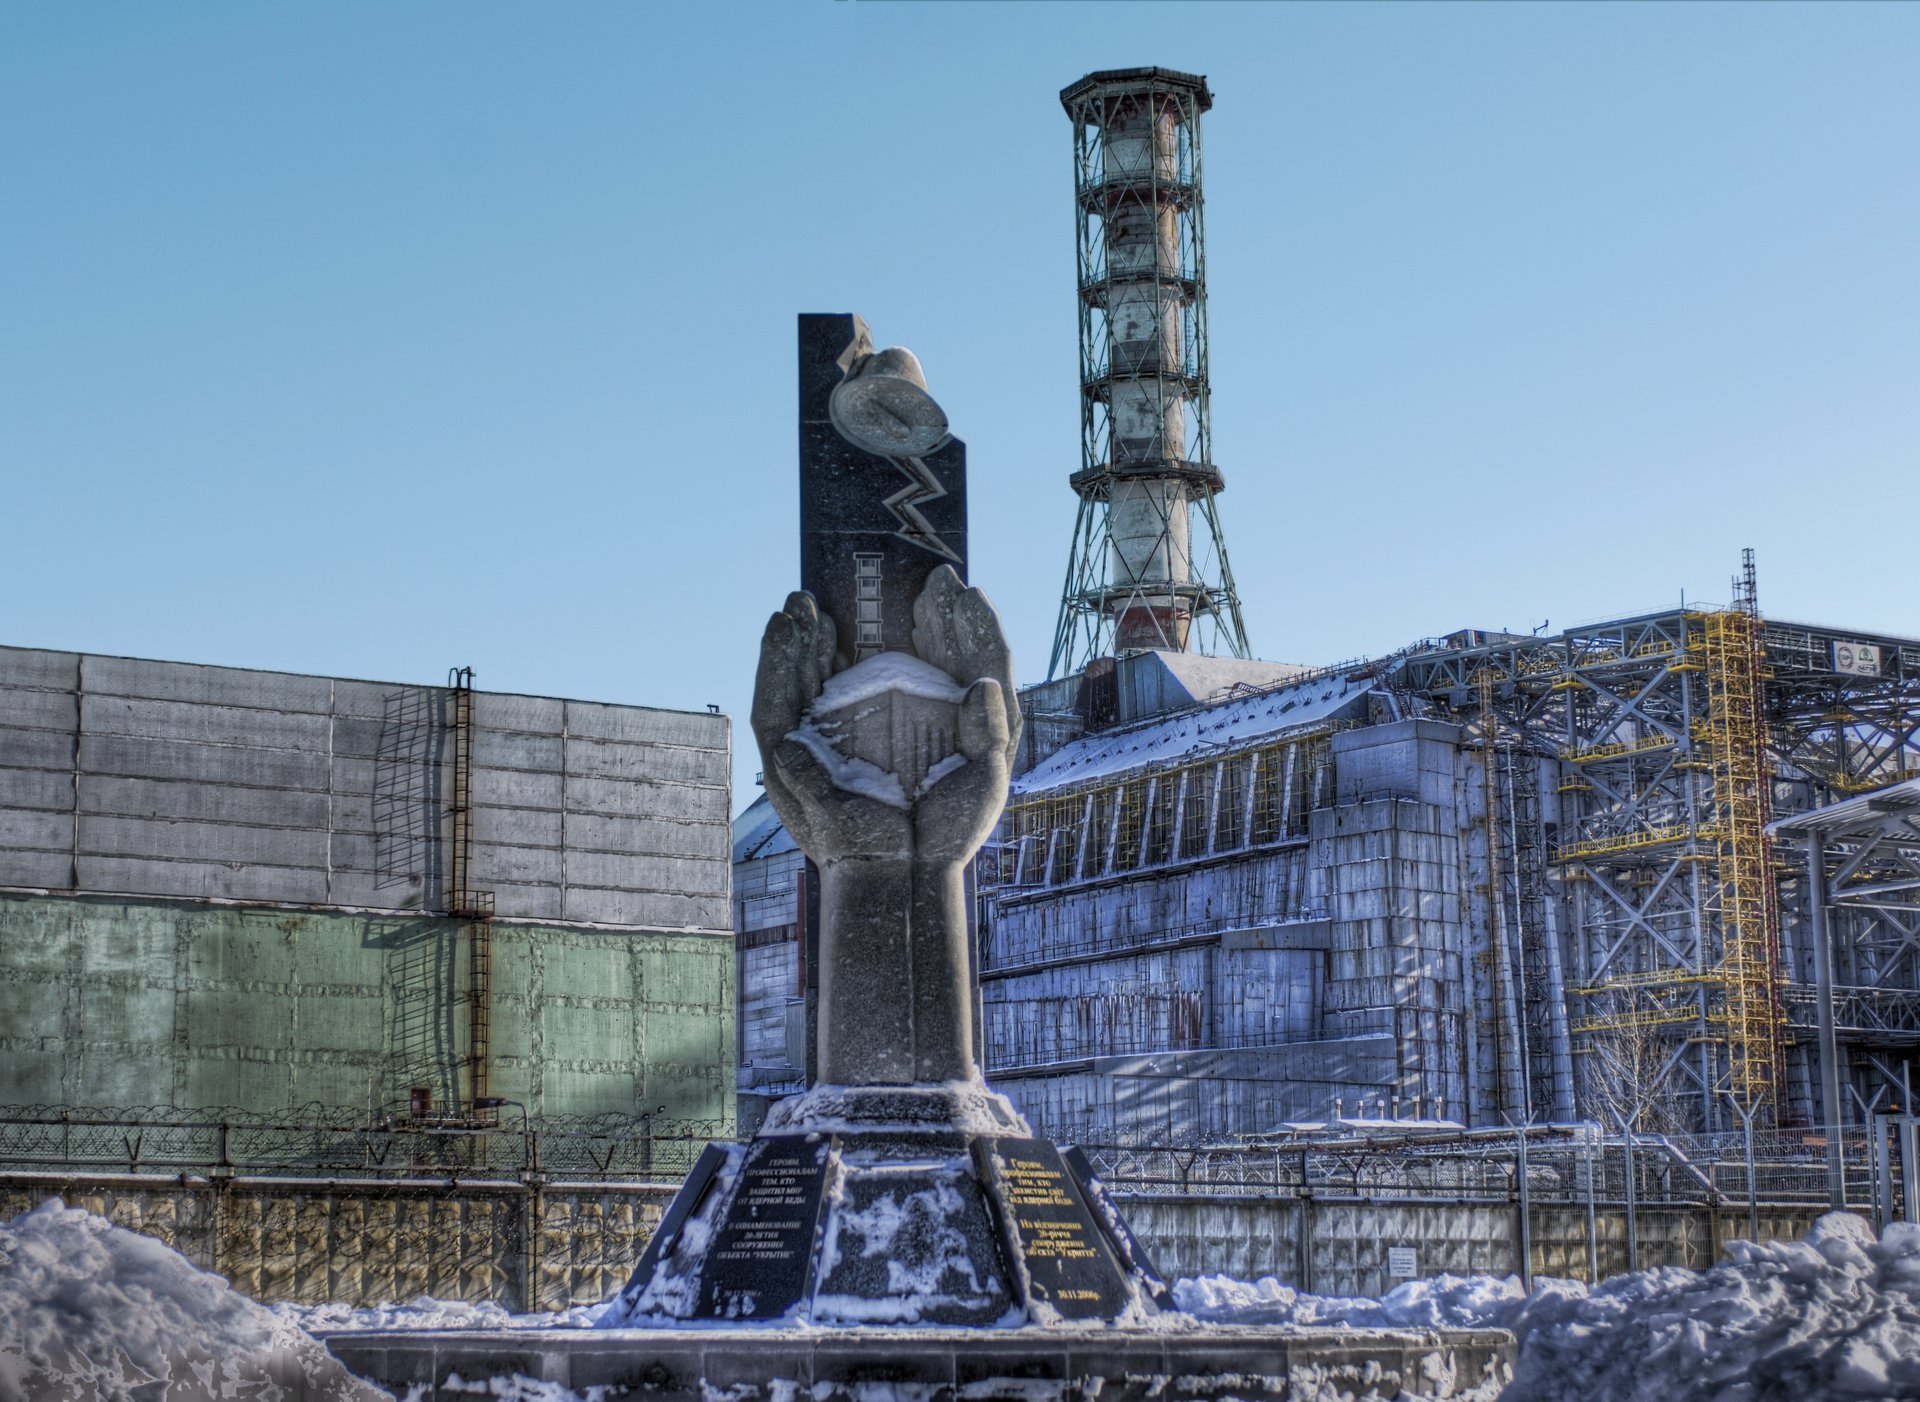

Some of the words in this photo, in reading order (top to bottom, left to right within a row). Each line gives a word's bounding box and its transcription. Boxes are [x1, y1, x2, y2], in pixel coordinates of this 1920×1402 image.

[749, 1187, 785, 1195] ЗАЩИТИЛ
[786, 1187, 803, 1195] МИР
[737, 1197, 748, 1205] ОТ
[748, 1196, 783, 1205] ЯДЕРНОЙ
[1020, 1219, 1033, 1229] На
[732, 1241, 784, 1249] СООРУЖЕНИЯ
[717, 1251, 751, 1259] ОБЪЕКТА
